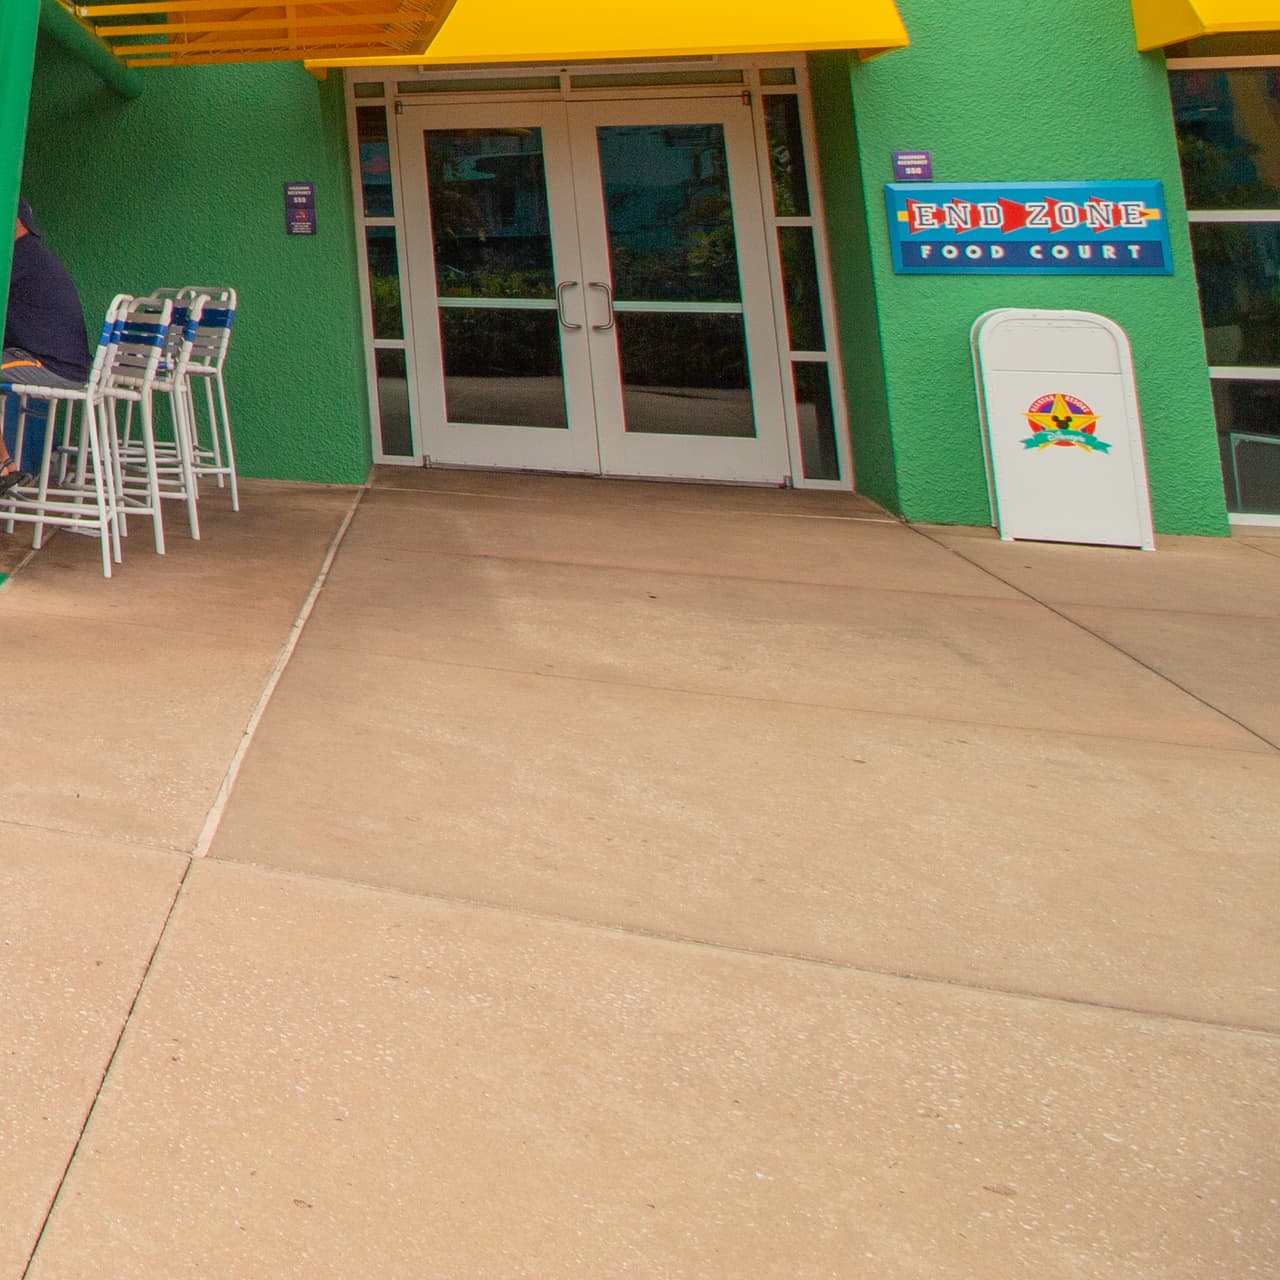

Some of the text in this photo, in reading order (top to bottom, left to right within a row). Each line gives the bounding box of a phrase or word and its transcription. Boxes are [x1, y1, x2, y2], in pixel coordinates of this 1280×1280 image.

[912, 201, 1148, 229] END ZONE
[920, 244, 1141, 260] FOOD COURT
